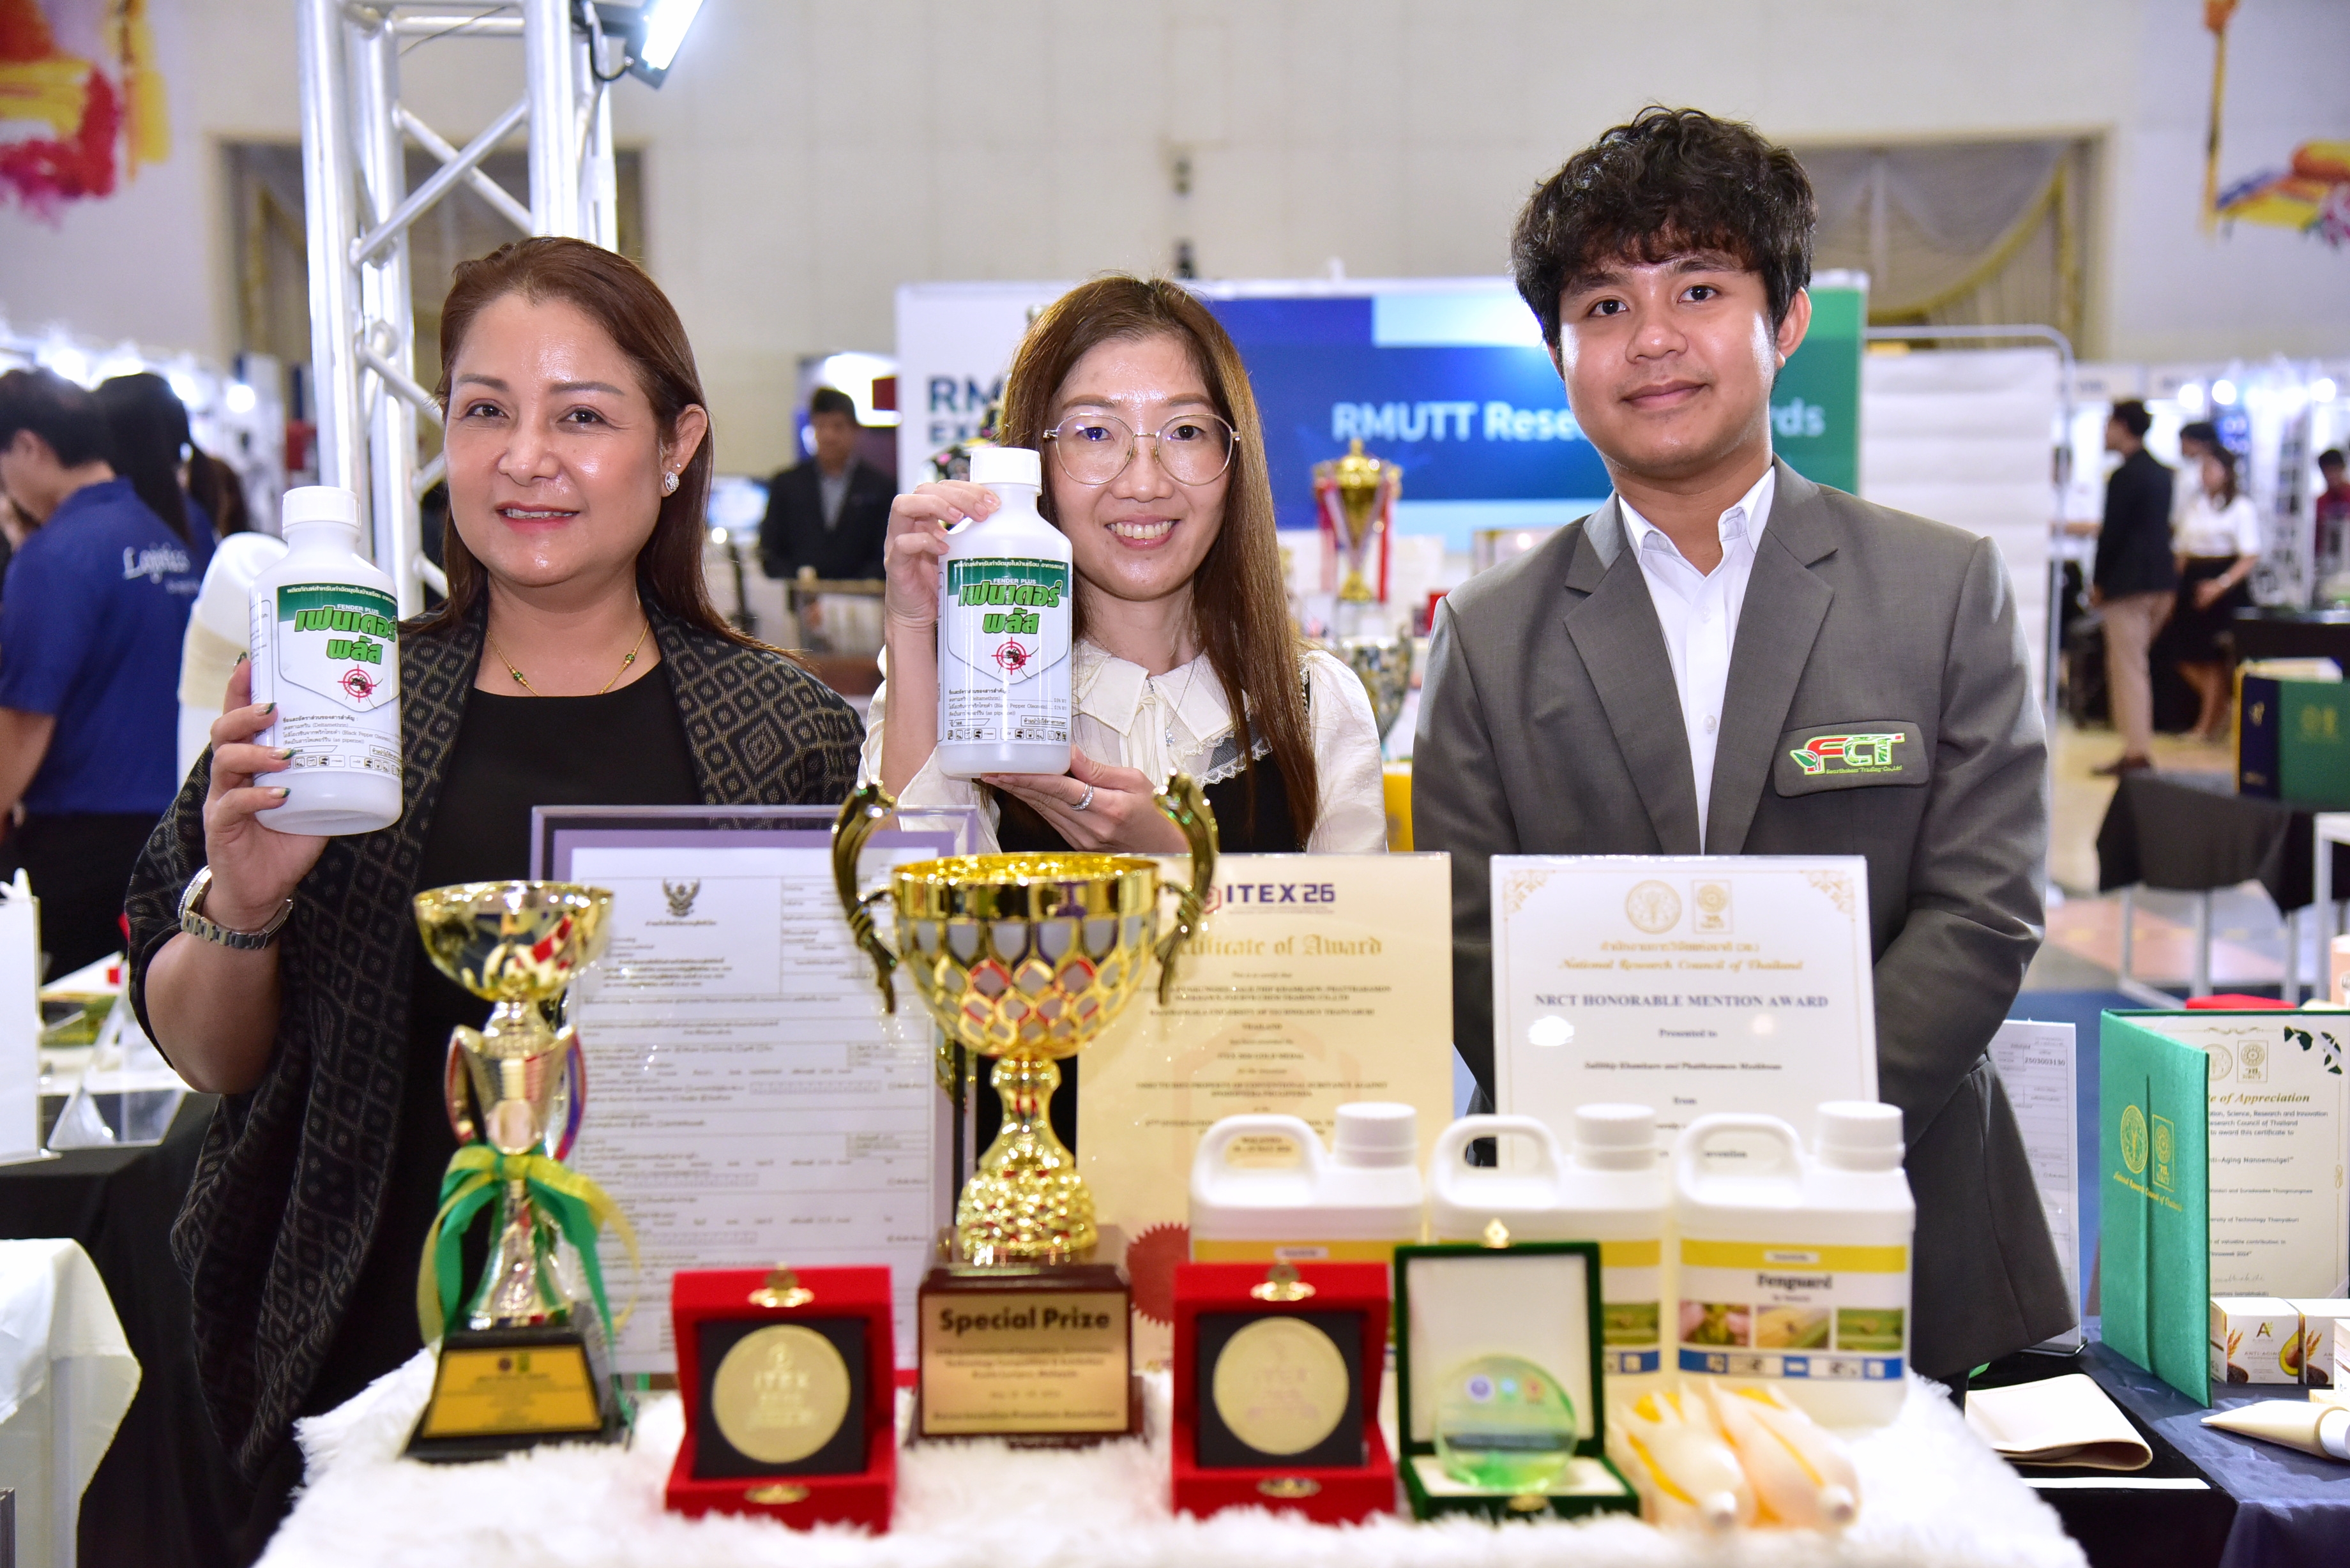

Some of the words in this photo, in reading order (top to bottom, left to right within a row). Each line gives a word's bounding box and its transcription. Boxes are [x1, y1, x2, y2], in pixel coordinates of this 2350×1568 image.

[1331, 401, 1478, 441] RMUTT
[1483, 400, 1589, 441] Rese
[958, 580, 1062, 607] เฟนเดอร์
[294, 606, 397, 642] เฟนเดอร์
[982, 608, 1040, 634] พลัส
[326, 635, 383, 665] พลัส
[1273, 934, 1294, 956] of
[1303, 933, 1383, 956] Award
[1558, 957, 1614, 970] National
[1619, 958, 1672, 970] Research
[1678, 958, 1725, 970] Council
[1729, 959, 1743, 973] of
[1748, 958, 1803, 970] Thailand
[1535, 994, 1577, 1006] NRCT
[1582, 994, 1683, 1007] HONORABLE
[1687, 995, 1763, 1007] MENTION
[1769, 995, 1829, 1007] AWARD
[1658, 1029, 1706, 1037] Presented
[2220, 1092, 2234, 1105] of
[2235, 1092, 2310, 1105] Appreciation
[939, 1306, 1036, 1338] Special
[1042, 1306, 1111, 1330] Prize
